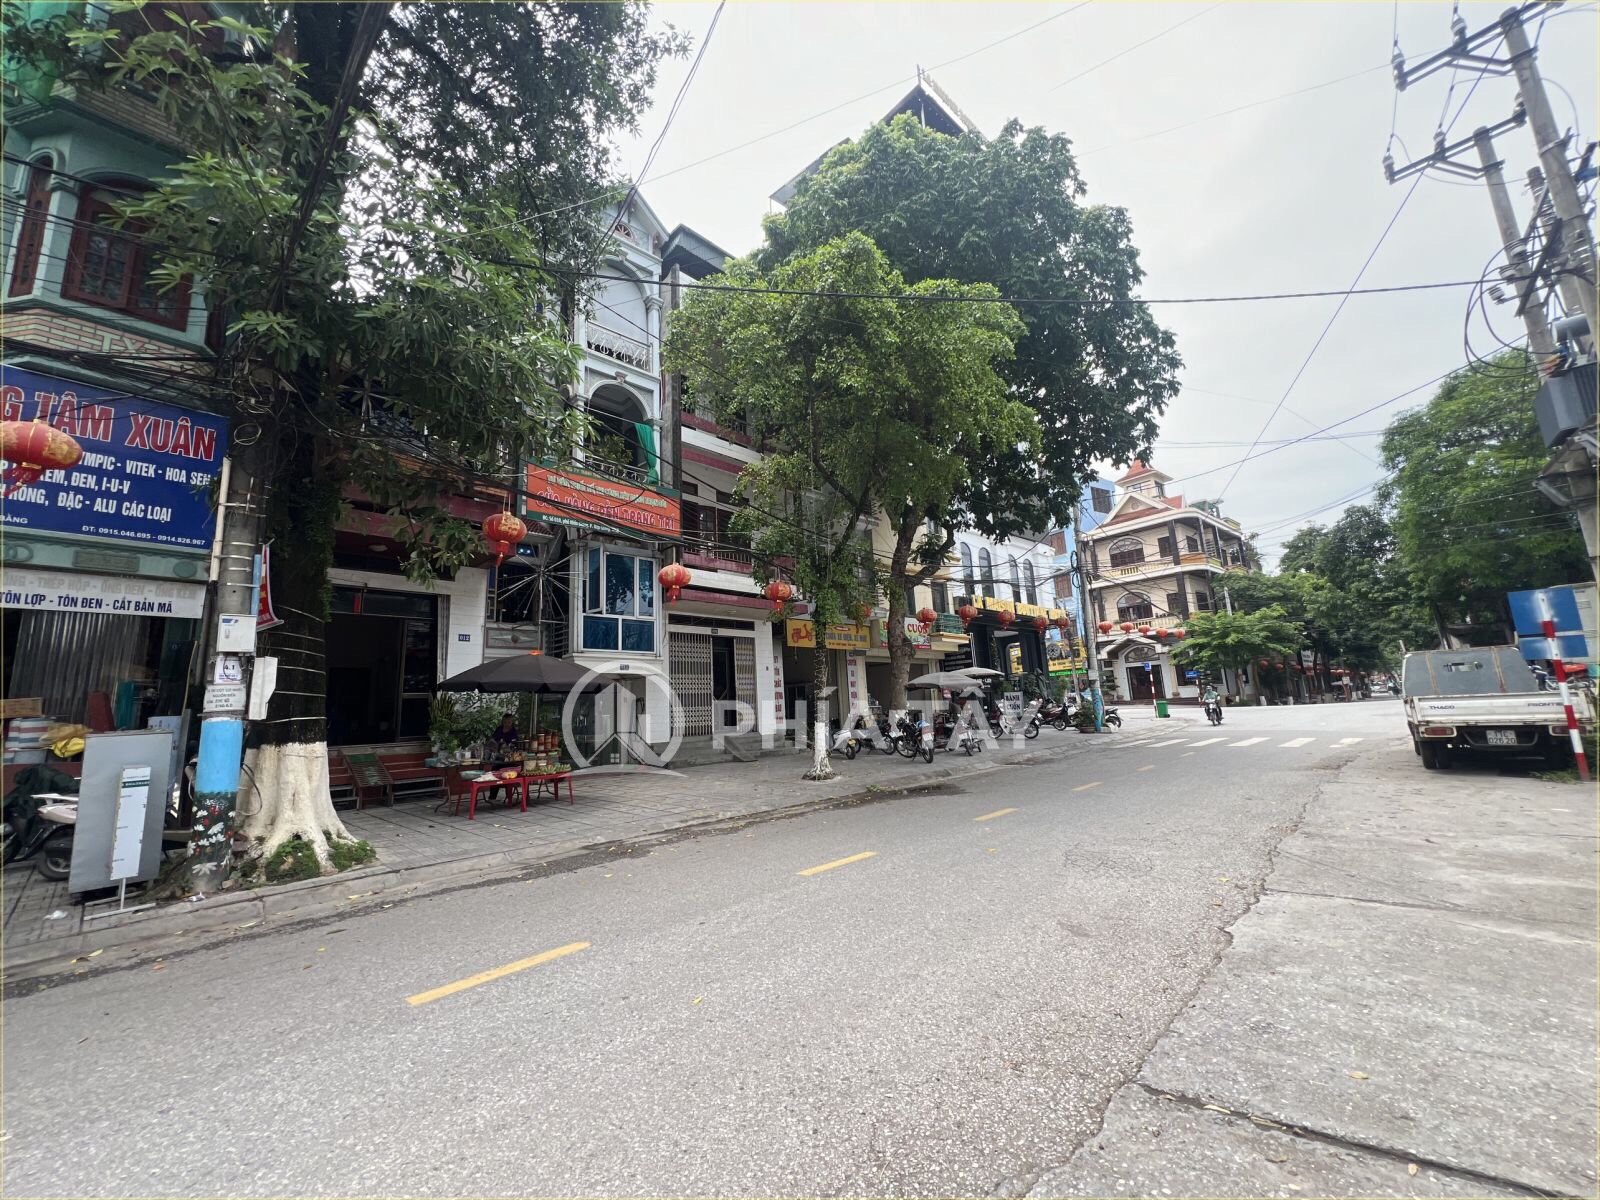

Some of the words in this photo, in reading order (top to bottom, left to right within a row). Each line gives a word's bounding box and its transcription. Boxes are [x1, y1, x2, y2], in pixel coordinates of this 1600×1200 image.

[34, 391, 115, 442] TÂM
[125, 411, 217, 461] XUÂN
[71, 472, 99, 492] ĐEN,
[101, 477, 131, 494] I-U-V
[125, 460, 157, 478] VITEK
[165, 467, 187, 483] HOA
[57, 491, 84, 511] ĐẶC
[93, 498, 117, 514] ALU
[121, 500, 145, 518] CÁC
[147, 505, 172, 523] LOẠI
[24, 593, 47, 608] LỢP
[57, 594, 79, 608] TÔN
[80, 597, 104, 610] ĐEN
